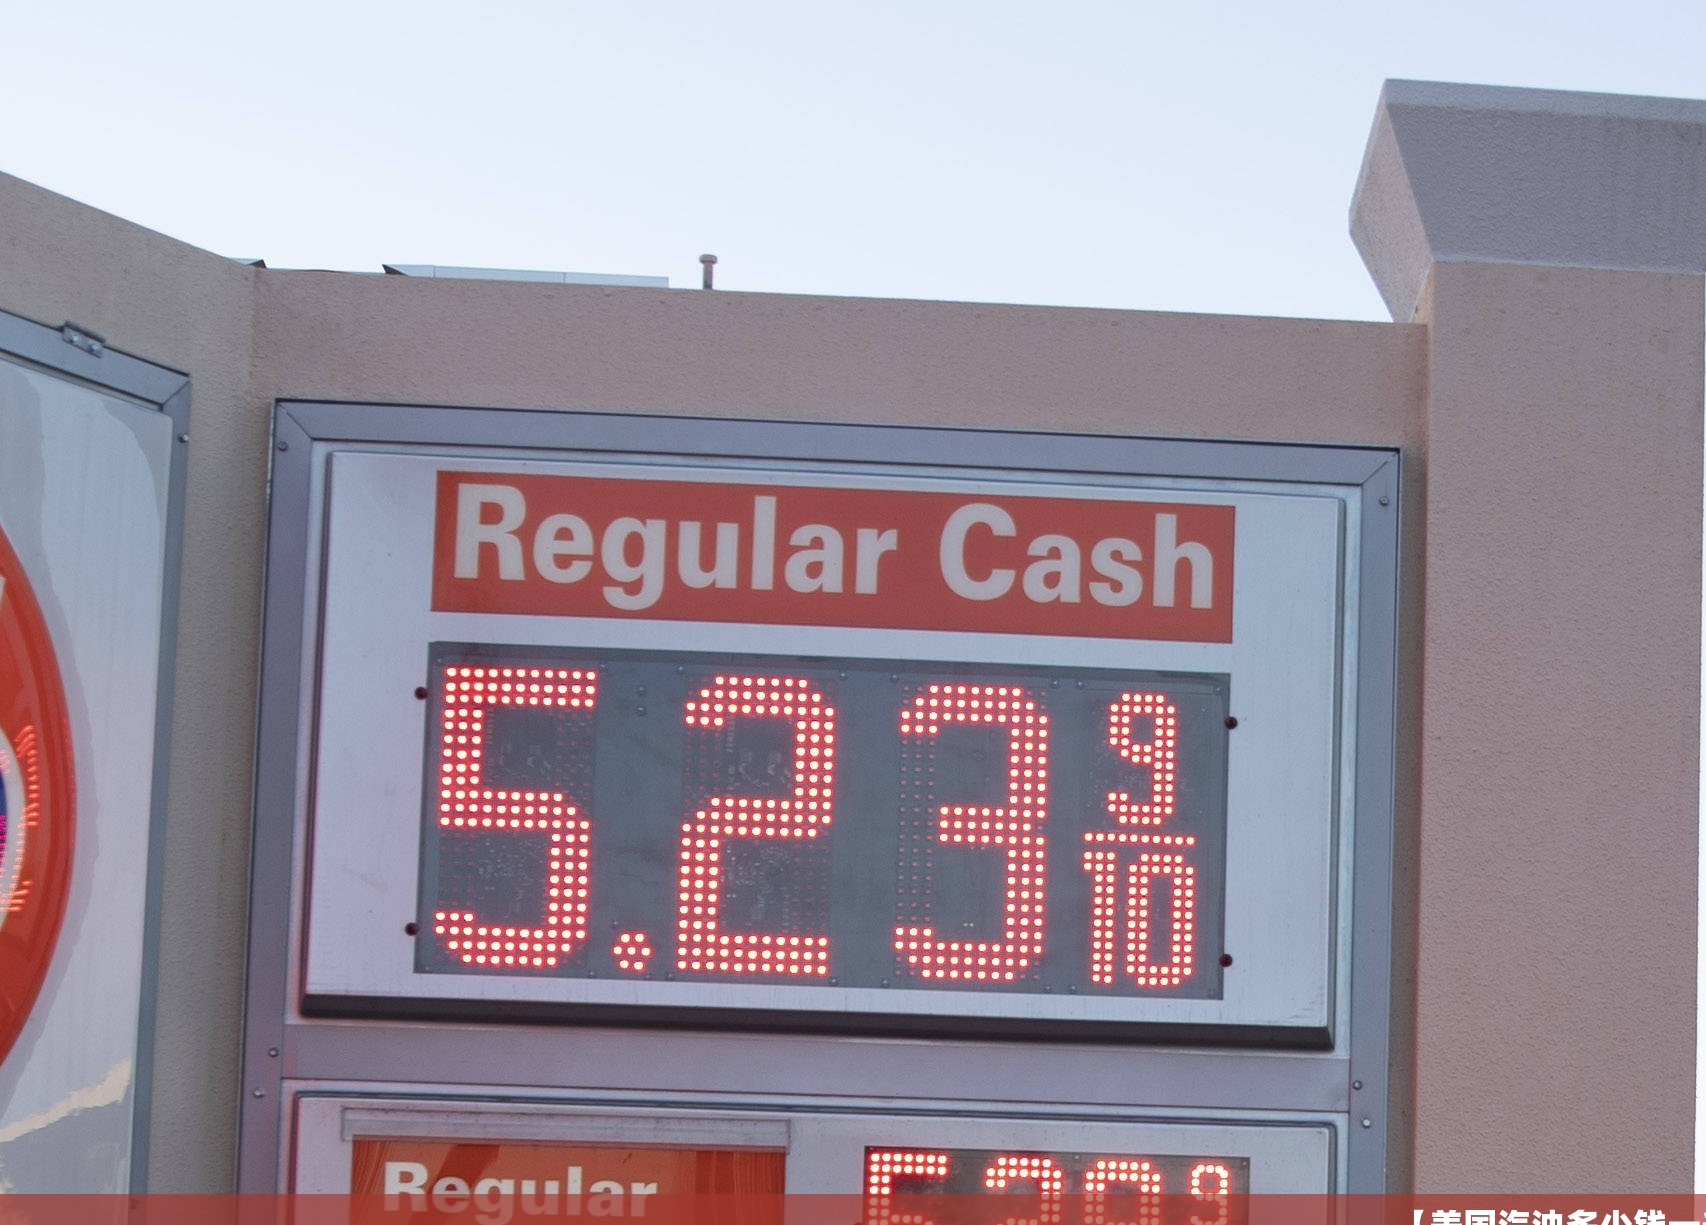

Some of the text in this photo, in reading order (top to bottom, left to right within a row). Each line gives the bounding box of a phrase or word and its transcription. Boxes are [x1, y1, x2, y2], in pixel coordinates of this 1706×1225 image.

[453, 482, 1216, 610] Regular Cash
[435, 667, 1048, 981] 5.23
